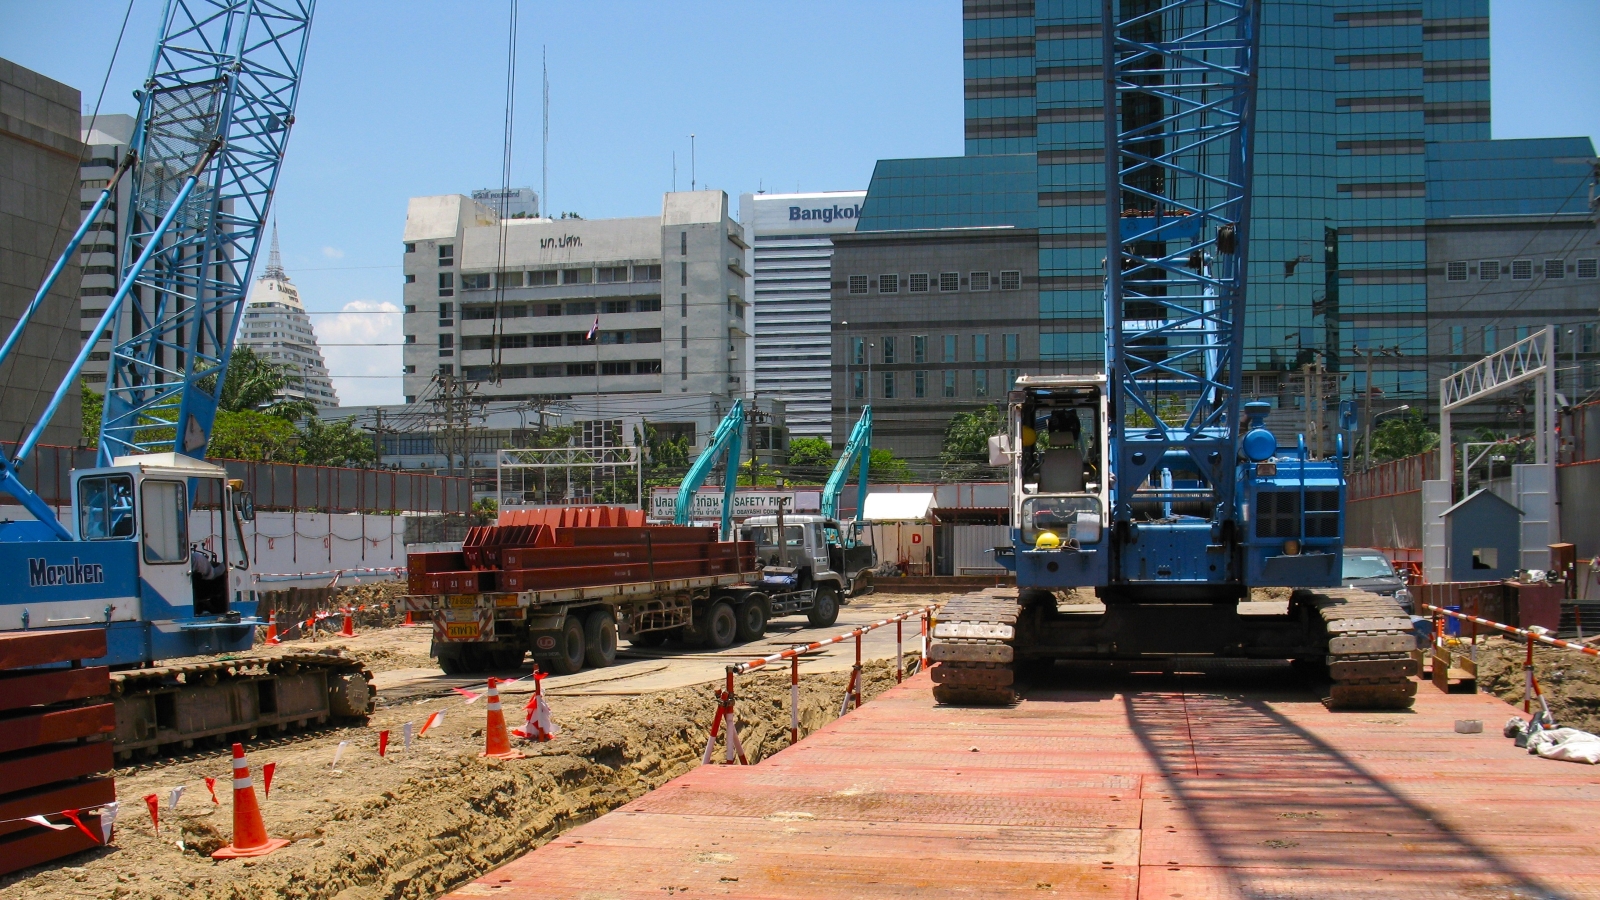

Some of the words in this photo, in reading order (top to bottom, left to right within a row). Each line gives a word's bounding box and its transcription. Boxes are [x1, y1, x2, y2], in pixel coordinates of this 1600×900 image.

[789, 204, 862, 223] Bangkok
[734, 497, 766, 506] SAFETY
[912, 533, 922, 544] D
[28, 556, 104, 587] Maruken
